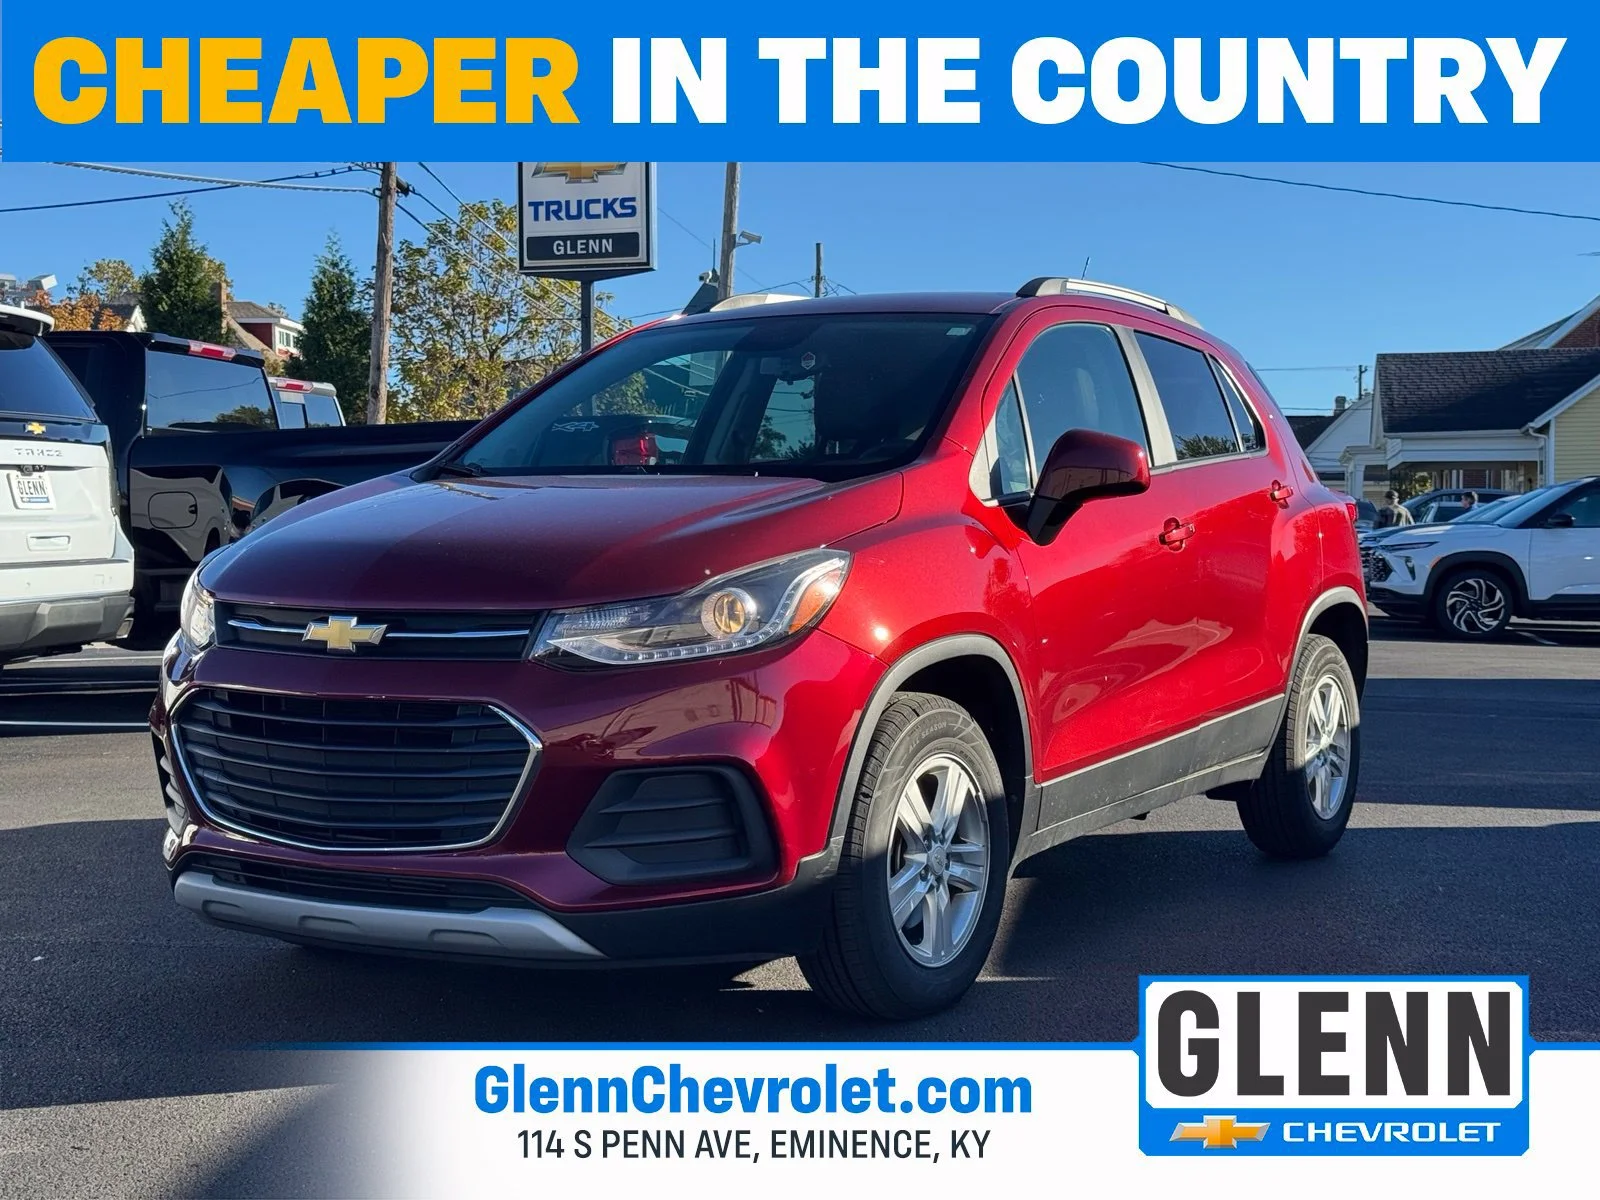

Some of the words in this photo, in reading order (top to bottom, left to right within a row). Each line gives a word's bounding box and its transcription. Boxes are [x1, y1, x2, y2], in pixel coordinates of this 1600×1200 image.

[528, 197, 637, 222] TRUCKS
[553, 238, 613, 256] GLENN
[17, 480, 47, 496] GLENN
